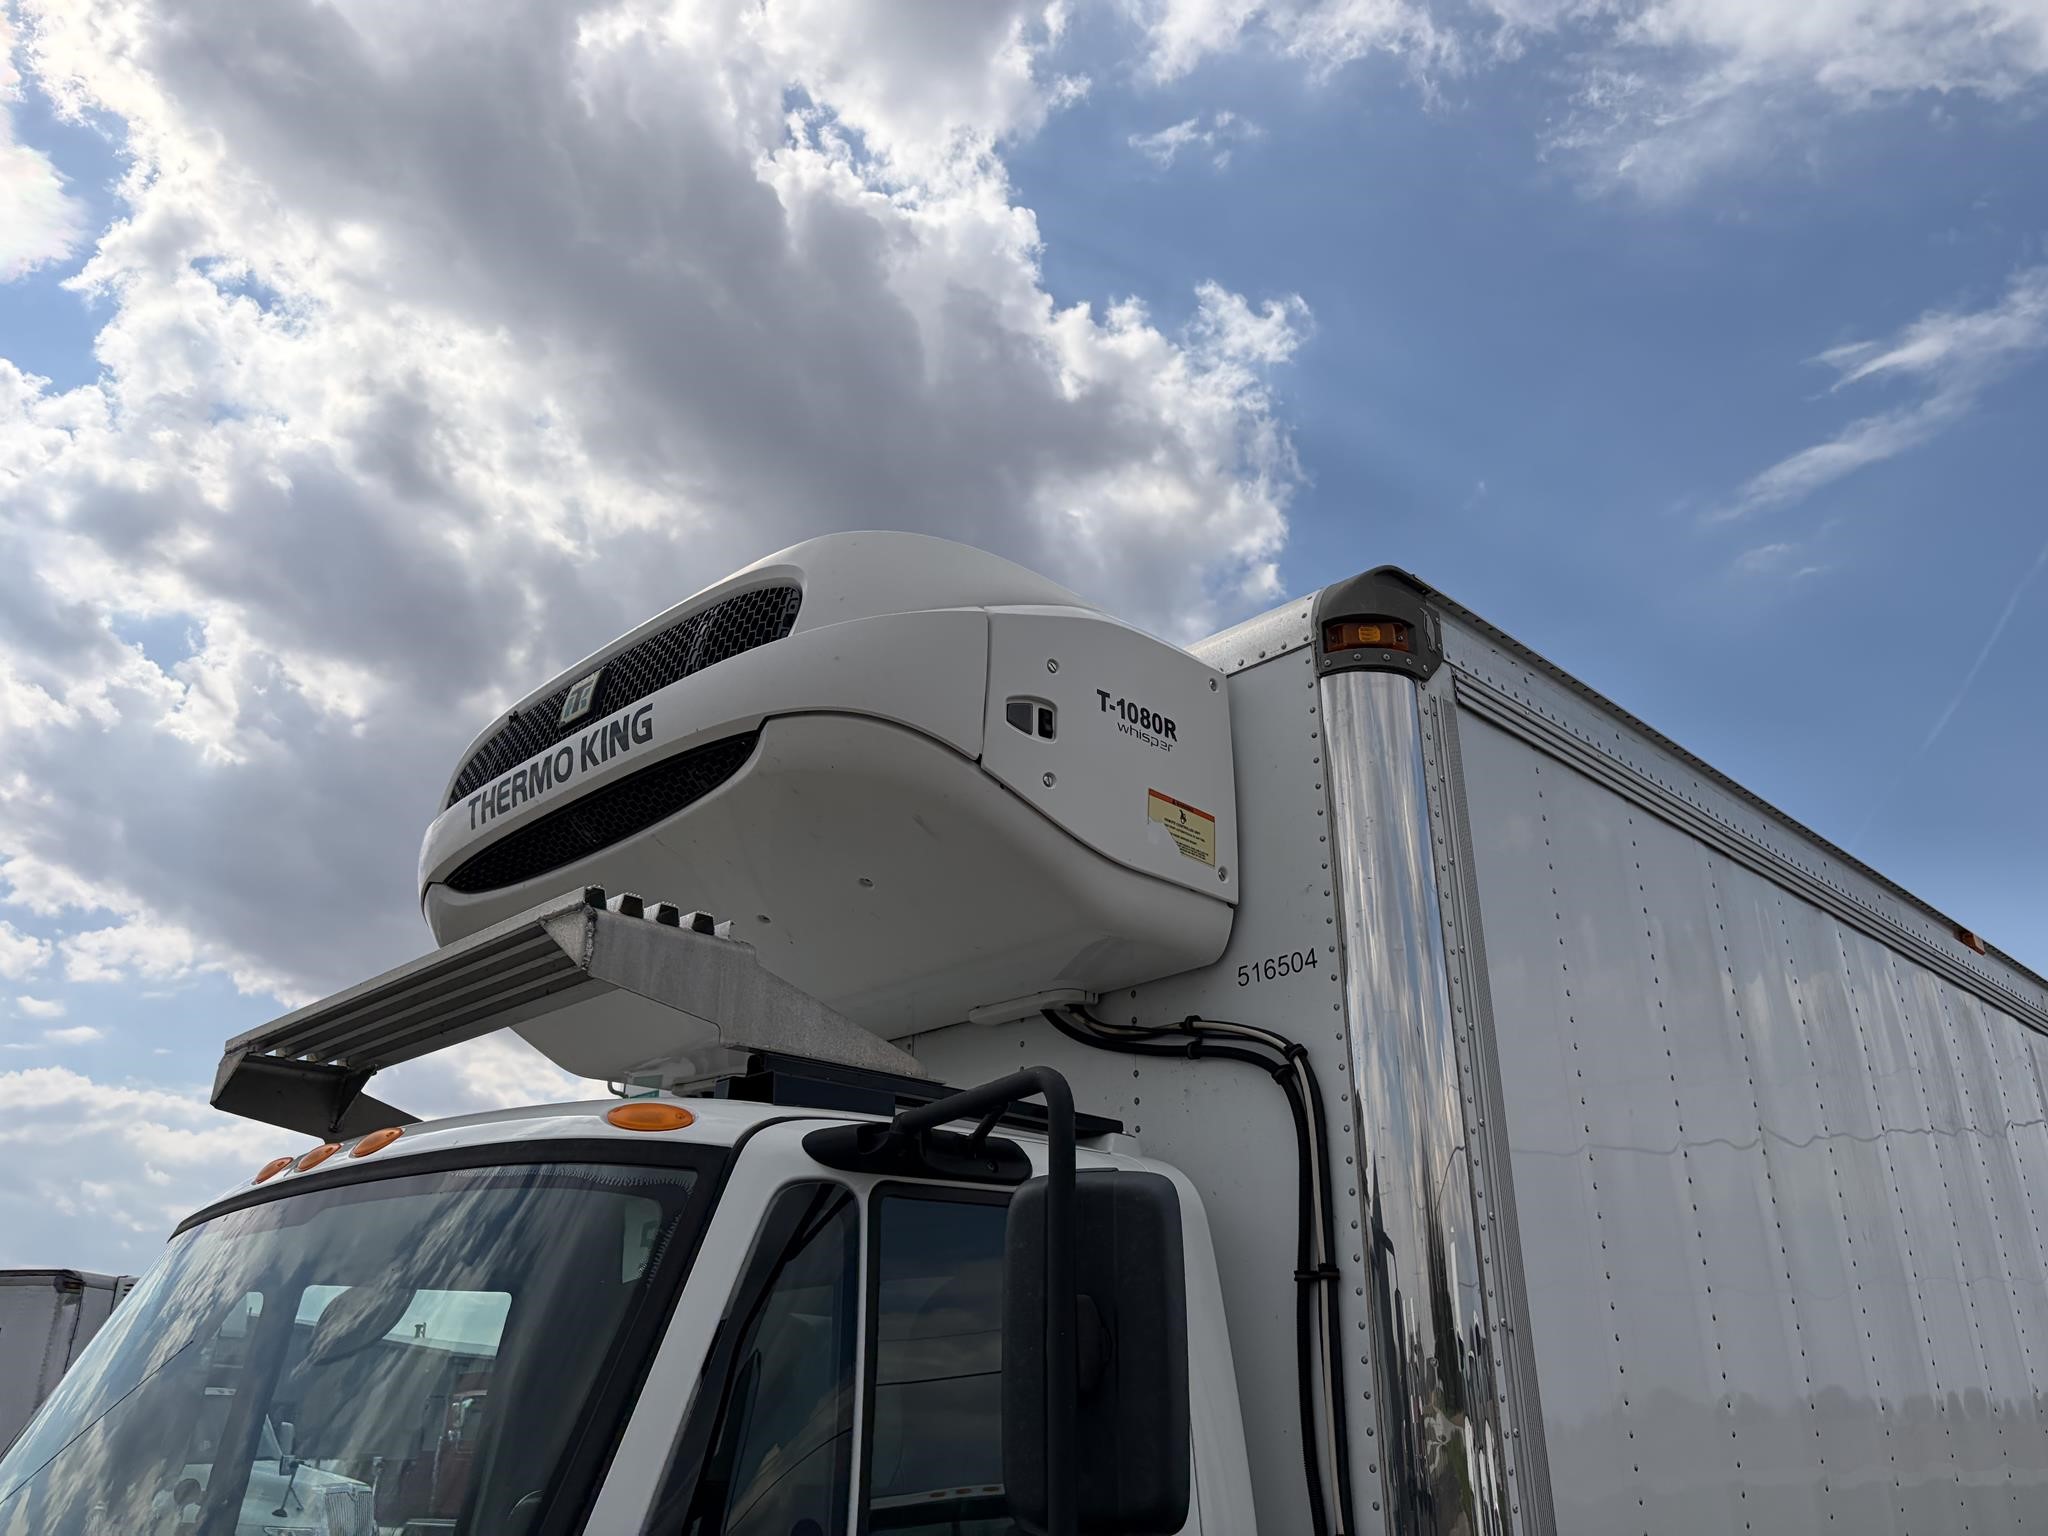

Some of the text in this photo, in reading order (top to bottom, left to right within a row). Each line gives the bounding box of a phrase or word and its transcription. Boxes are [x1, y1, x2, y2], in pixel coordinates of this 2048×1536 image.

[1096, 688, 1178, 742] T-1080R
[1117, 721, 1174, 752] whisper
[467, 703, 654, 831] THERMO KING
[1237, 947, 1318, 987] 516504
